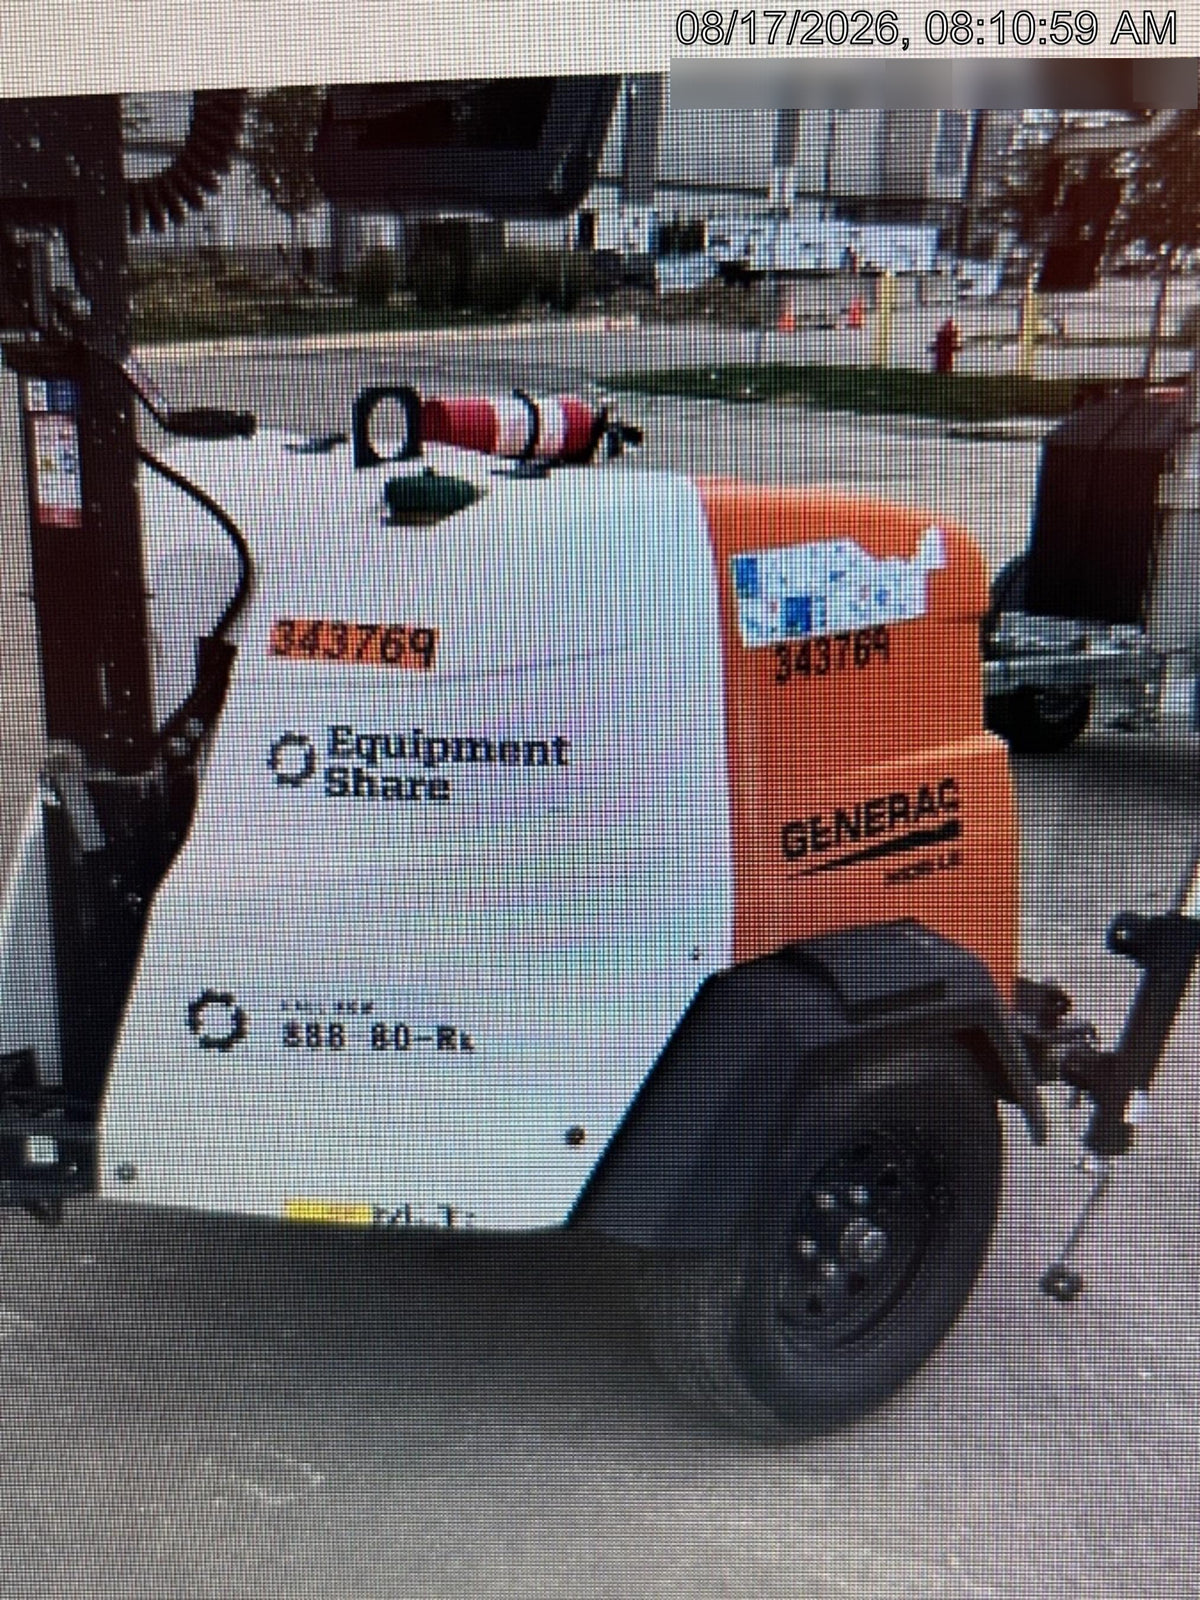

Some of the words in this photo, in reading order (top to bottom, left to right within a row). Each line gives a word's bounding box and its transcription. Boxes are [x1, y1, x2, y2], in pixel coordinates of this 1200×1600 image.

[271, 619, 437, 668] 343769
[325, 724, 569, 767] Equipment
[323, 767, 450, 801] Share
[780, 777, 960, 859] GENERAC
